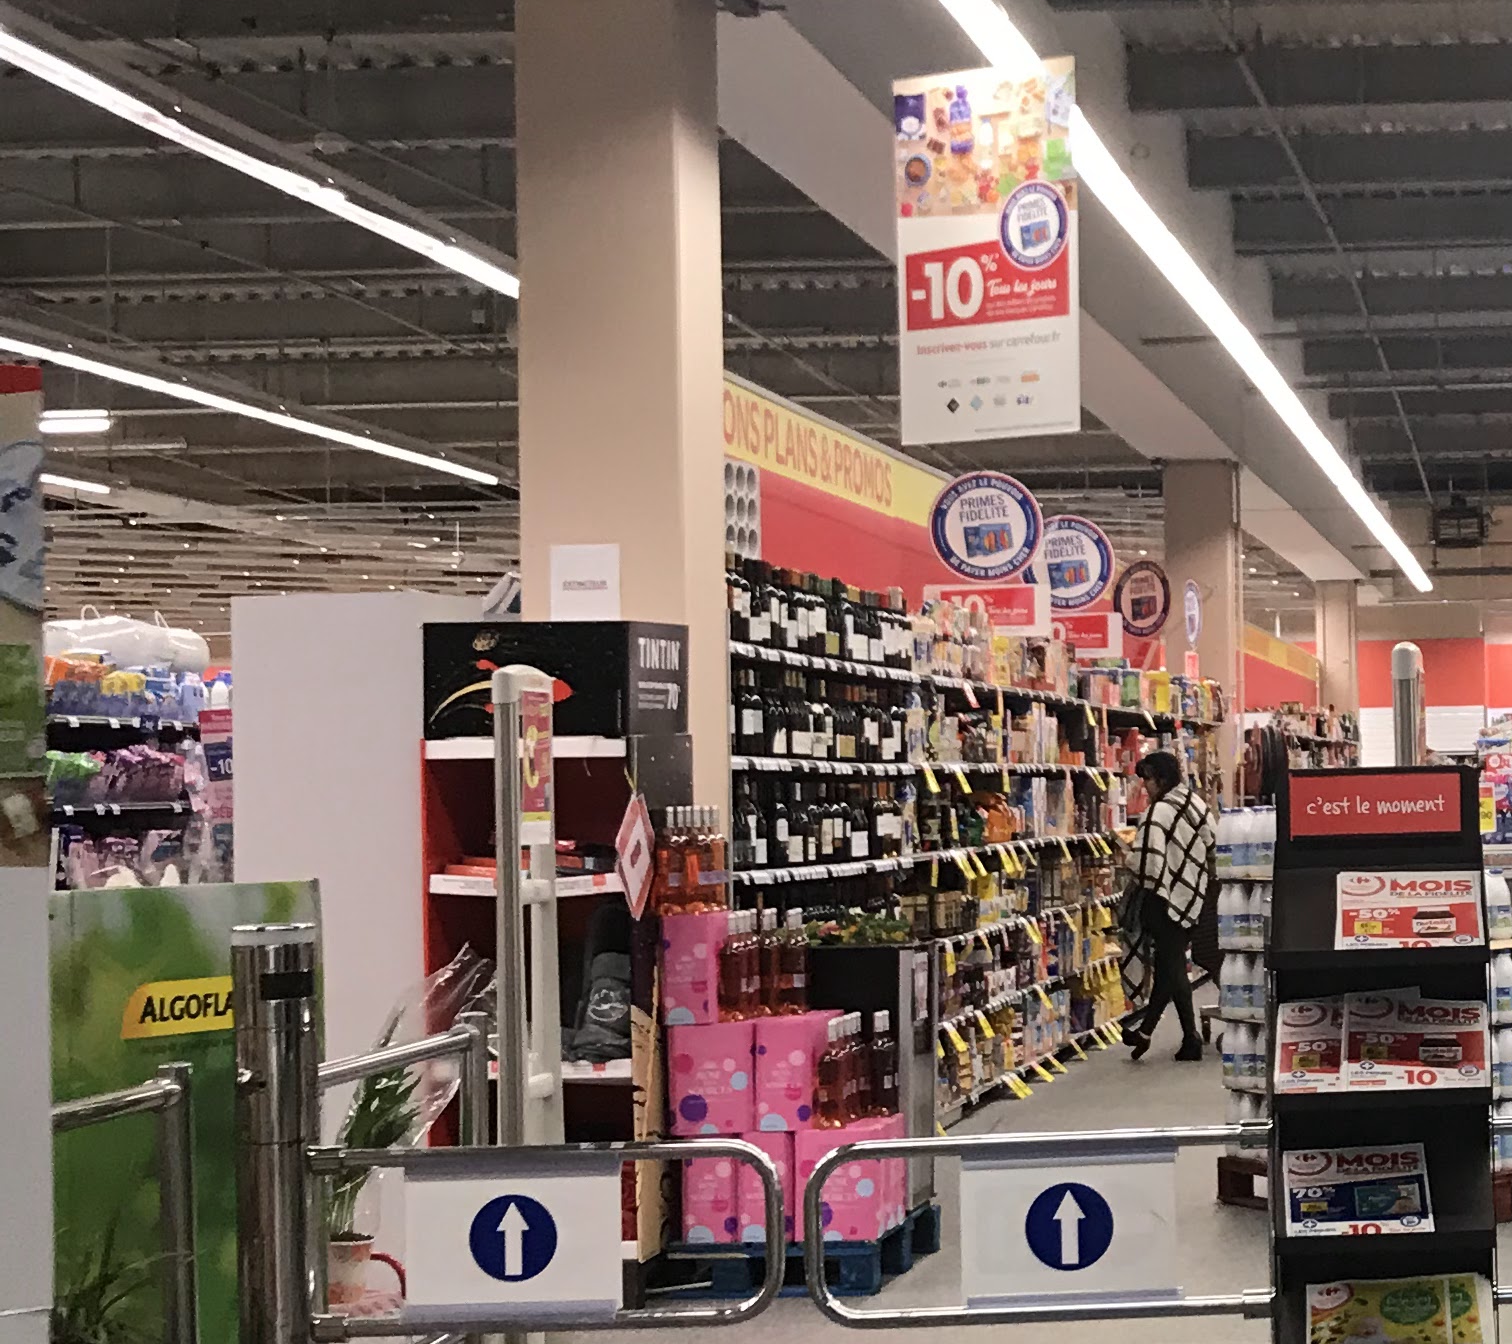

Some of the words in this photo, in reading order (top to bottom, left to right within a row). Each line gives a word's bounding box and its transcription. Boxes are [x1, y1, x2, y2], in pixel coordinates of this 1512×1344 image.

[763, 408, 818, 479] PLANS
[820, 433, 833, 484] &
[833, 438, 893, 508] PROMOS
[978, 478, 988, 487] LE
[990, 478, 1024, 500] POUVOIR
[959, 494, 1006, 510] PRIMES
[959, 506, 1010, 523] FIDELITE
[637, 636, 681, 670] TINTIN
[1356, 795, 1370, 814] le
[1377, 794, 1446, 815] moment
[1390, 879, 1473, 892] MOIS
[1349, 908, 1400, 919] -50%
[1399, 1003, 1481, 1019] MOIS
[1337, 1151, 1420, 1168] MOIS
